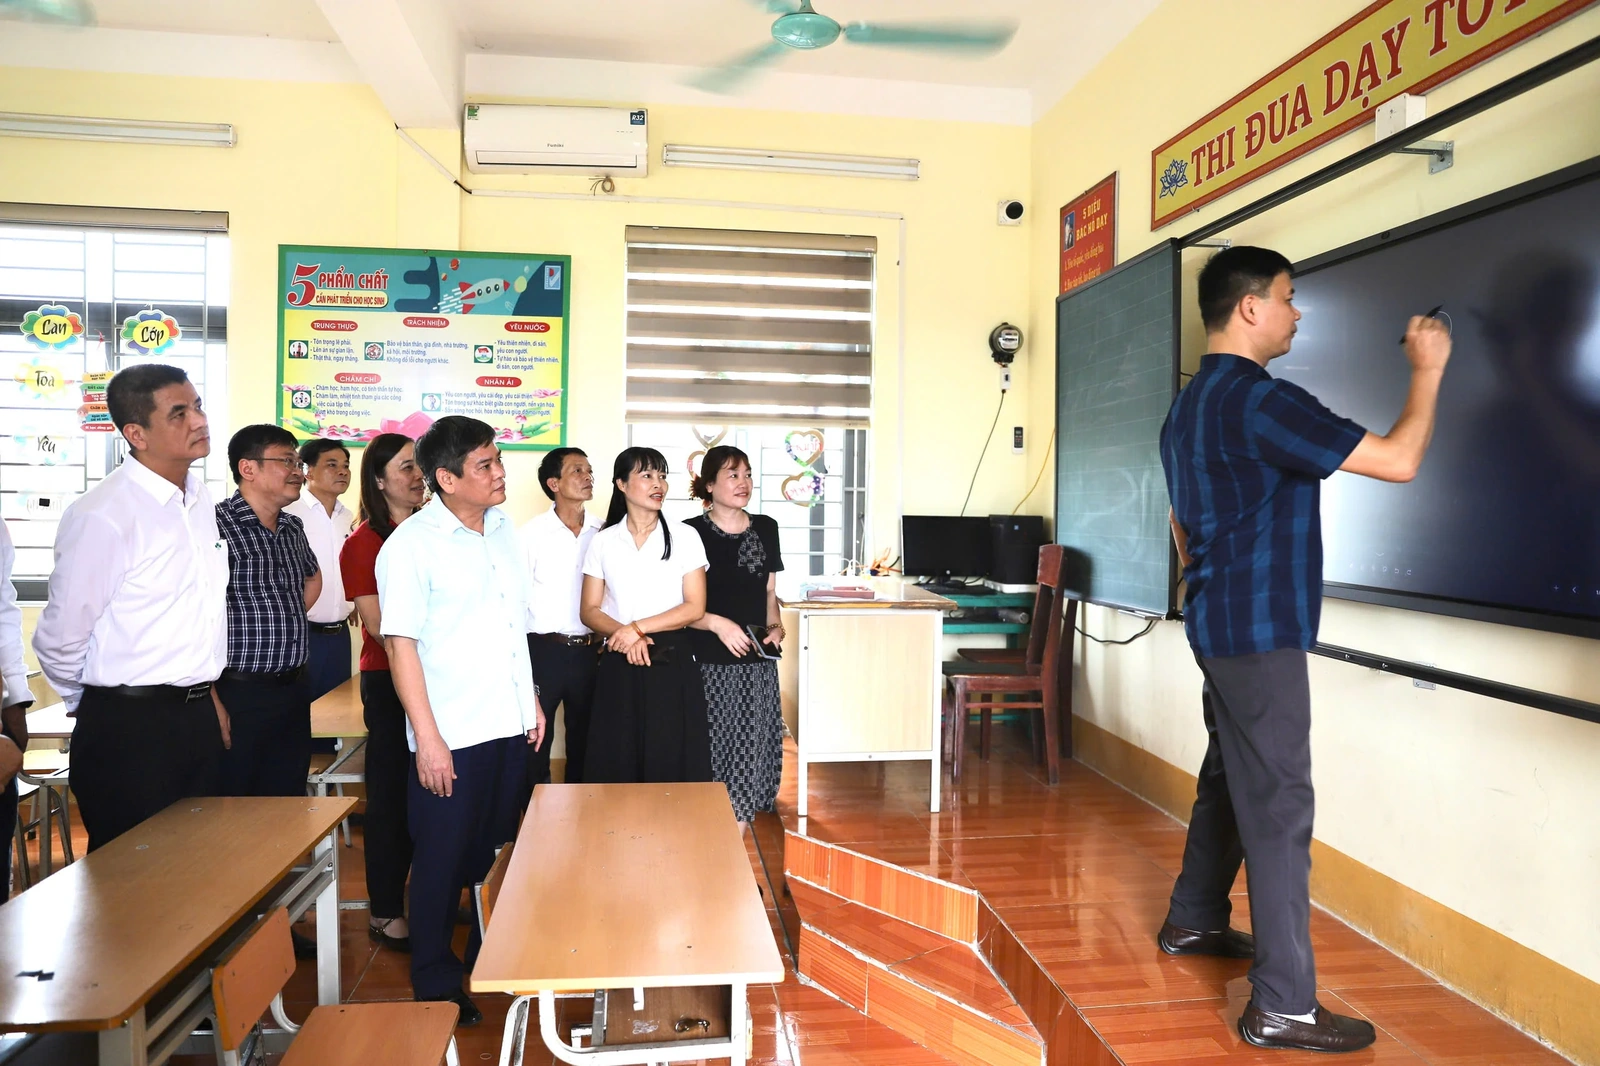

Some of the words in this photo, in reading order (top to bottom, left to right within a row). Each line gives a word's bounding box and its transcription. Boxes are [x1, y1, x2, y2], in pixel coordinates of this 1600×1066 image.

[1191, 126, 1236, 188] THI
[1245, 84, 1312, 159] ĐUA
[1323, 16, 1411, 116] DẠY
[1083, 208, 1086, 220] 5
[1096, 213, 1108, 230] DẠY
[287, 264, 320, 306] 5
[319, 265, 354, 288] PHẨM
[358, 268, 389, 289] CHẤT
[327, 294, 339, 304] PHÁT
[340, 292, 352, 304] TRIỂN
[364, 297, 374, 307] HỌC
[41, 319, 67, 336] Lan
[141, 326, 164, 346] Lớp
[37, 435, 56, 453] Yêu
